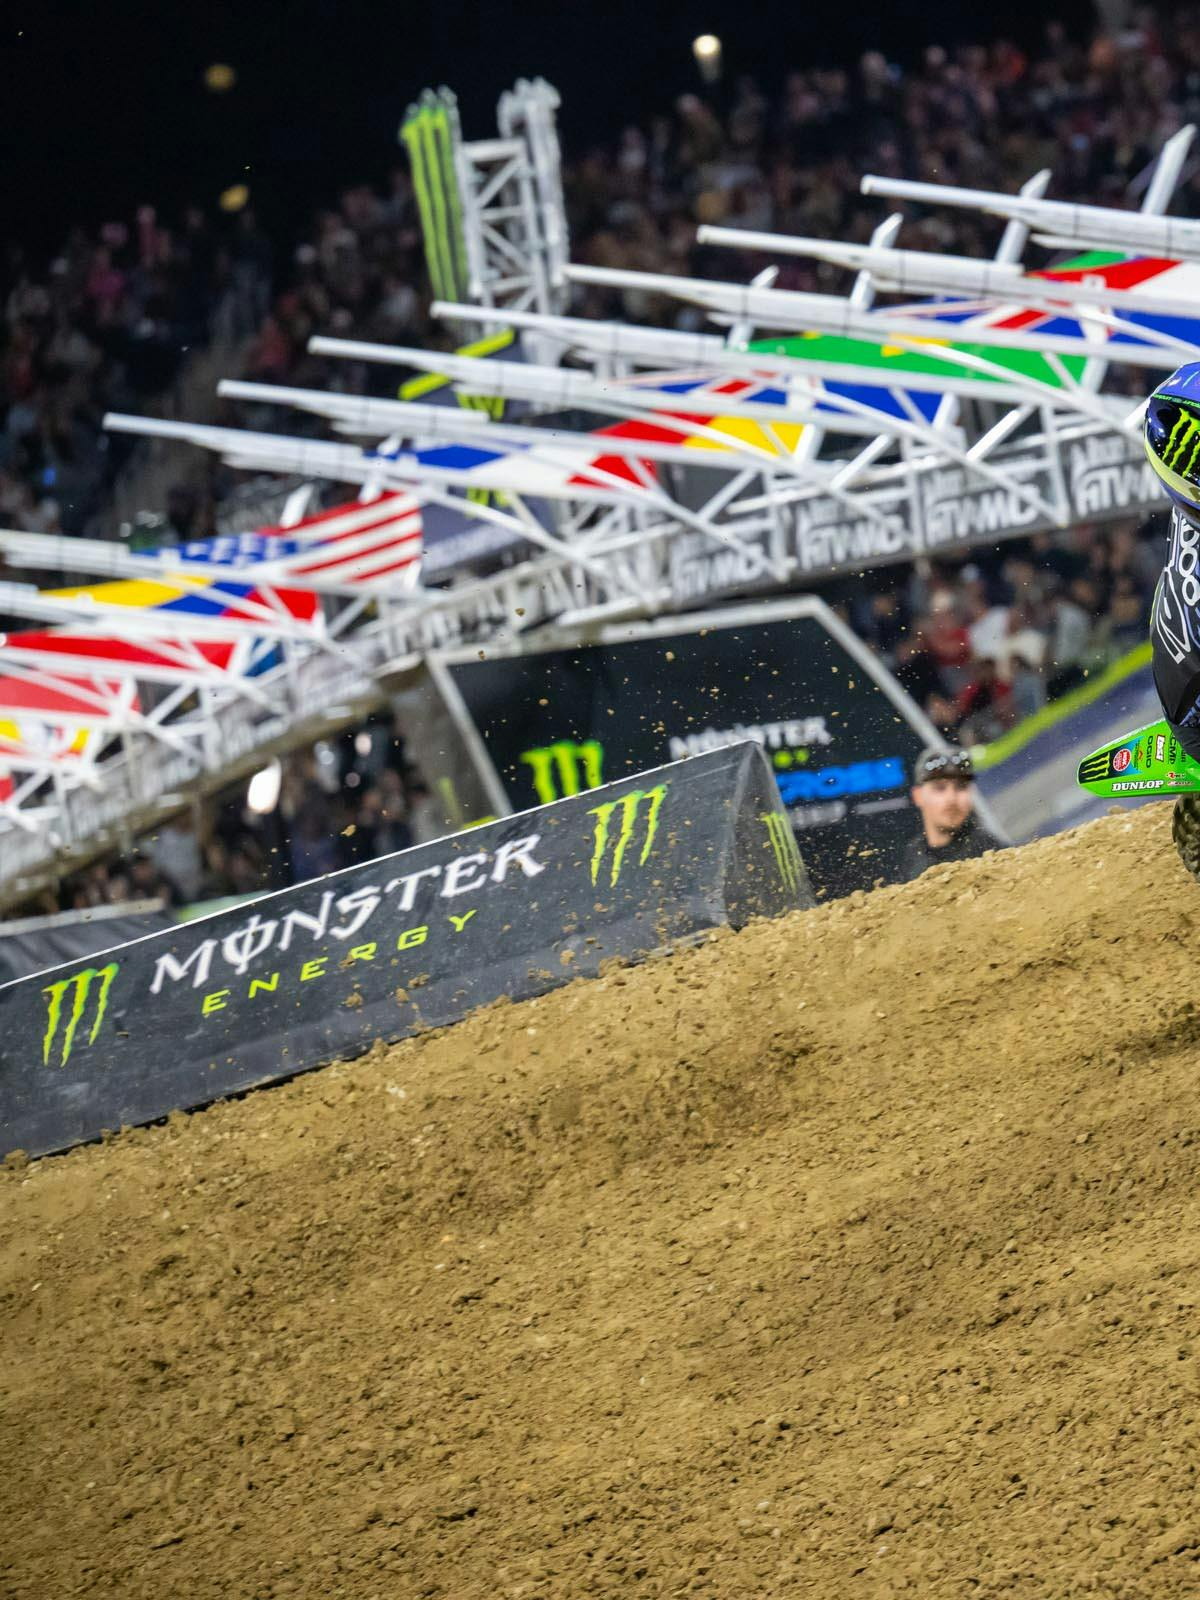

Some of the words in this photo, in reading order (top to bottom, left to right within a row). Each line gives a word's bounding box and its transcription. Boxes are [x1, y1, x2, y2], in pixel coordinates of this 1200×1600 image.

[1112, 780, 1164, 791] DUNLOP
[1145, 735, 1154, 768] OGIO
[149, 833, 546, 995] MONSTER
[201, 908, 478, 1017] ENERGY
